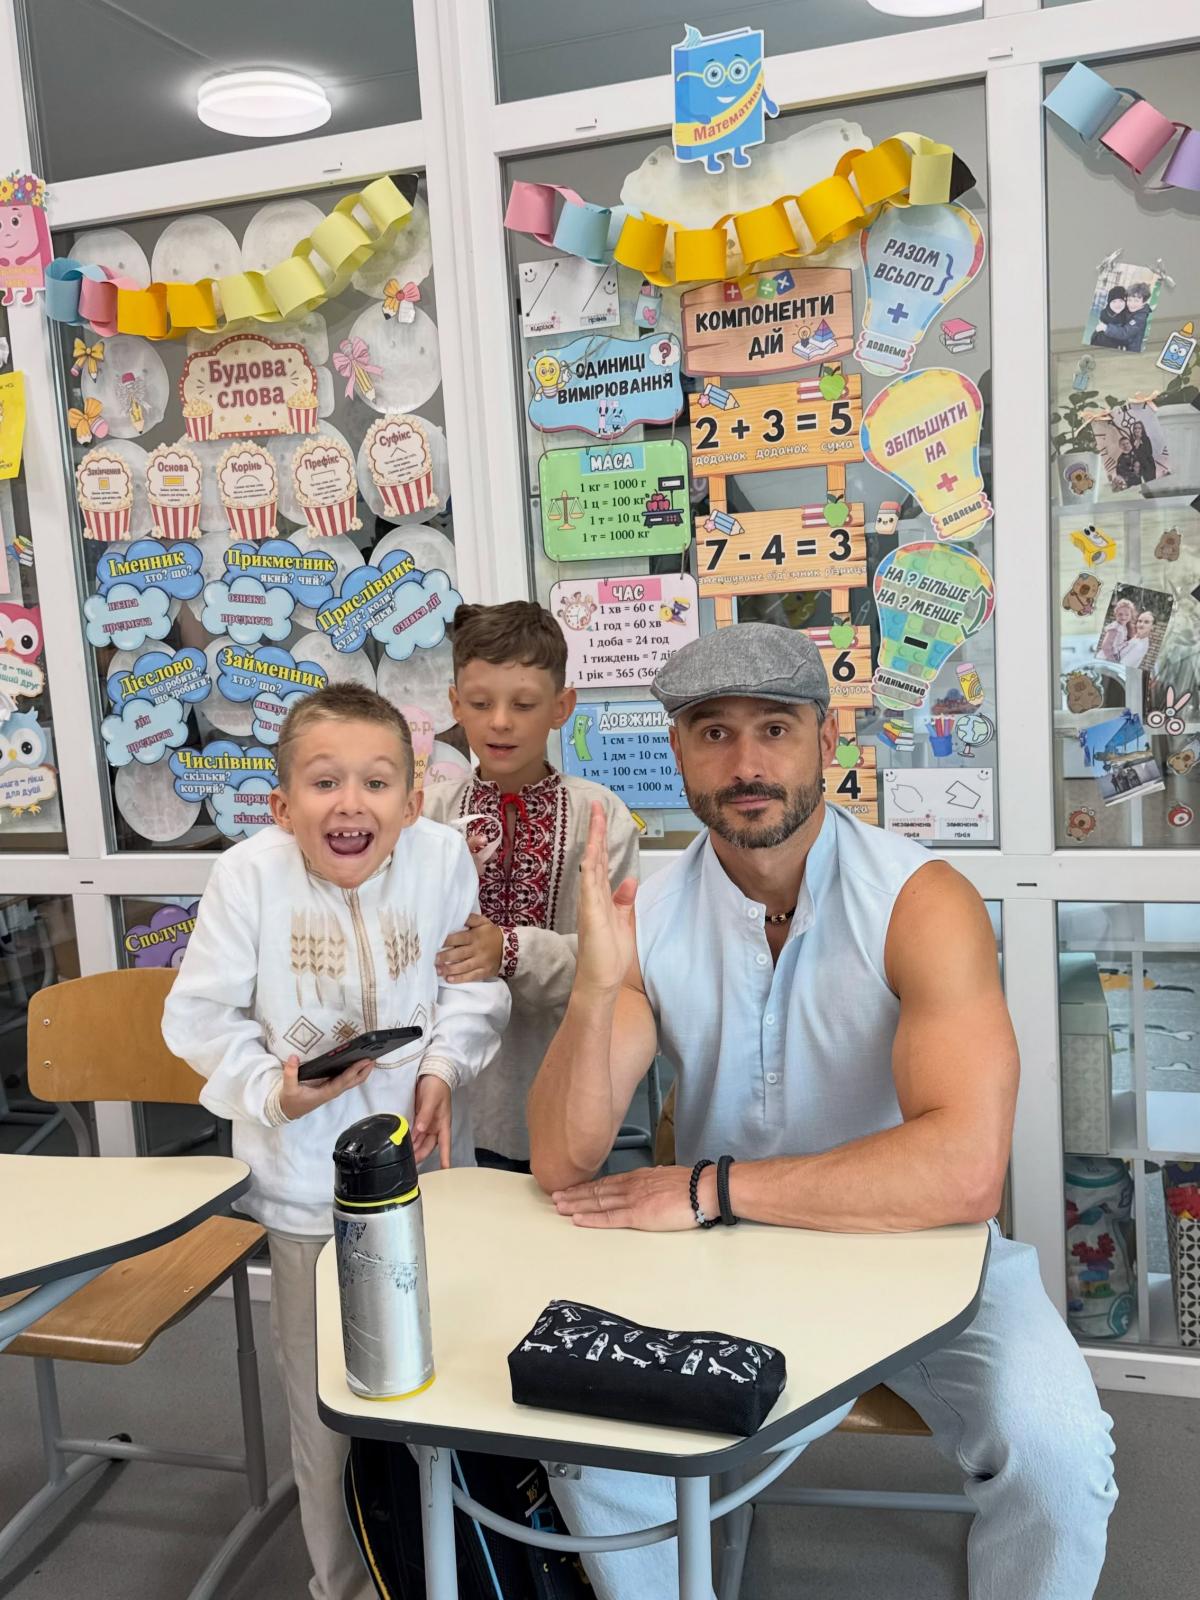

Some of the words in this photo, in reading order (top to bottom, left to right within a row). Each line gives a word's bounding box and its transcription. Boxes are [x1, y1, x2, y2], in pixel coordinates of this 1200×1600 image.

[693, 83, 762, 141] Математика
[883, 239, 940, 267] РАЗОМ
[874, 263, 935, 292] ВСЬОГО
[695, 294, 834, 333] КОМПОНЕНТИ
[748, 327, 784, 360] ДІЙ
[208, 359, 287, 387] Будова
[576, 353, 645, 380] ОДИНИЦІ
[217, 386, 285, 408] слова
[558, 373, 673, 405] ВИМІРЮВАННЯ
[695, 416, 719, 449] 2
[763, 409, 785, 442] 3
[830, 401, 852, 436] 5
[885, 401, 968, 457] ЗБІЛЬШИТИ
[379, 430, 412, 448] Суфікс
[695, 452, 747, 466] доданок
[756, 444, 809, 460] доданок
[821, 440, 854, 453] сума
[925, 441, 947, 463] НА
[157, 461, 189, 473] Основа
[231, 462, 262, 474] Корінь
[304, 454, 340, 471] Префікс
[590, 453, 634, 472] МАСА
[588, 484, 601, 492] кг
[613, 479, 638, 490] 1000
[612, 497, 631, 507] 100
[617, 513, 630, 524] 10
[610, 530, 635, 541] 1000
[638, 530, 650, 539] кг
[705, 538, 728, 571] 7
[761, 534, 786, 565] 4
[829, 529, 852, 562] 3
[108, 552, 186, 577] Іменник
[227, 548, 336, 572] Прикметник
[144, 570, 168, 584] хто?
[171, 565, 193, 580] що?
[260, 573, 295, 584] який?
[298, 574, 326, 586] чий?
[611, 584, 645, 602] ЧАС
[884, 566, 904, 583] НА
[907, 573, 917, 586] ?
[918, 576, 970, 603] БІЛЬШЕ
[228, 593, 267, 605] ознака
[317, 557, 415, 632] Прислівник
[367, 589, 395, 615] коли?
[107, 598, 140, 612] назва
[392, 605, 428, 635] ознака
[426, 592, 442, 614] дії
[608, 606, 622, 615] хв
[633, 603, 646, 613] 60
[649, 604, 655, 612] с
[877, 588, 896, 605] НА
[899, 595, 910, 609] ?
[910, 599, 962, 625] МЕНШЕ
[603, 623, 622, 632] год
[633, 619, 646, 629] 60
[649, 620, 662, 629] хв
[597, 637, 623, 648] доба
[635, 635, 648, 645] 24
[651, 636, 670, 646] год
[590, 653, 640, 664] тиждень
[651, 651, 658, 661] 7
[832, 650, 856, 682] 6
[223, 647, 326, 689] Займенник
[586, 669, 604, 682] рік
[616, 668, 634, 679] 365
[20, 678, 41, 691] друг
[120, 657, 193, 700] Дієслово
[149, 685, 164, 697] що
[165, 666, 203, 693] робити?
[231, 675, 257, 688] хто?
[259, 681, 282, 694] що?
[154, 693, 169, 706] що
[171, 673, 211, 699] зробити?
[829, 685, 869, 697] обуток
[599, 711, 675, 731] ДОВЖИНА
[610, 737, 625, 745] см
[637, 734, 650, 744] 10
[652, 736, 670, 744] мм
[178, 751, 277, 771] Числівник
[611, 753, 627, 762] дм
[639, 750, 651, 760] 10
[654, 752, 668, 760] см
[183, 770, 232, 782] скільки?
[591, 769, 600, 777] м
[613, 766, 631, 777] 100
[633, 768, 648, 776] см
[660, 765, 672, 776] 10
[180, 783, 225, 796] котрий?
[610, 784, 625, 792] км
[637, 781, 662, 792] 1000
[664, 783, 673, 791] м
[836, 769, 861, 800] 4
[234, 793, 270, 806] поряд
[234, 811, 274, 825] кількіс
[124, 917, 197, 952] Сполучн
